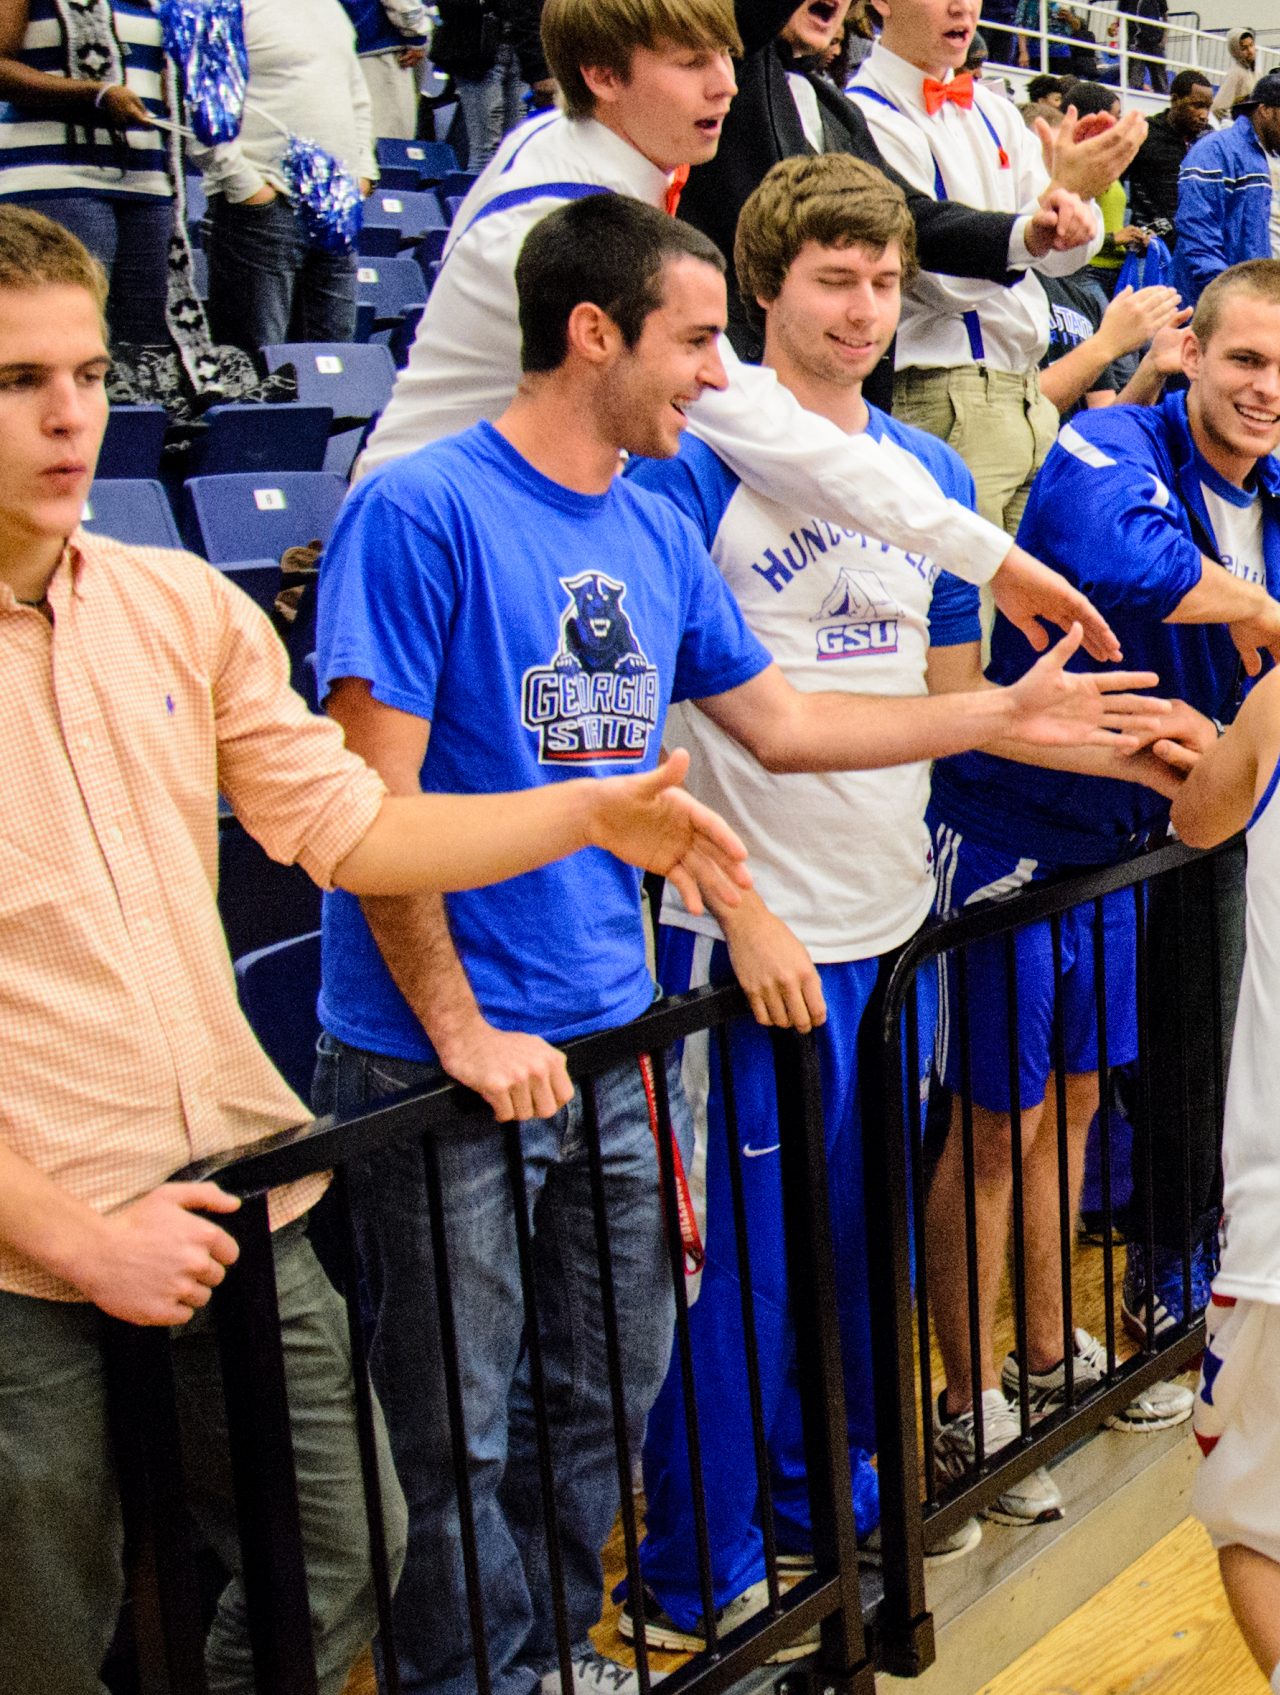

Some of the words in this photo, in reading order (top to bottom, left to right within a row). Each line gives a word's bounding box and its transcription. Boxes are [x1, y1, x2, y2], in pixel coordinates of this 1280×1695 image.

[816, 620, 898, 655] GSU
[528, 671, 658, 724] GEORGIA
[547, 714, 647, 751] STATE
